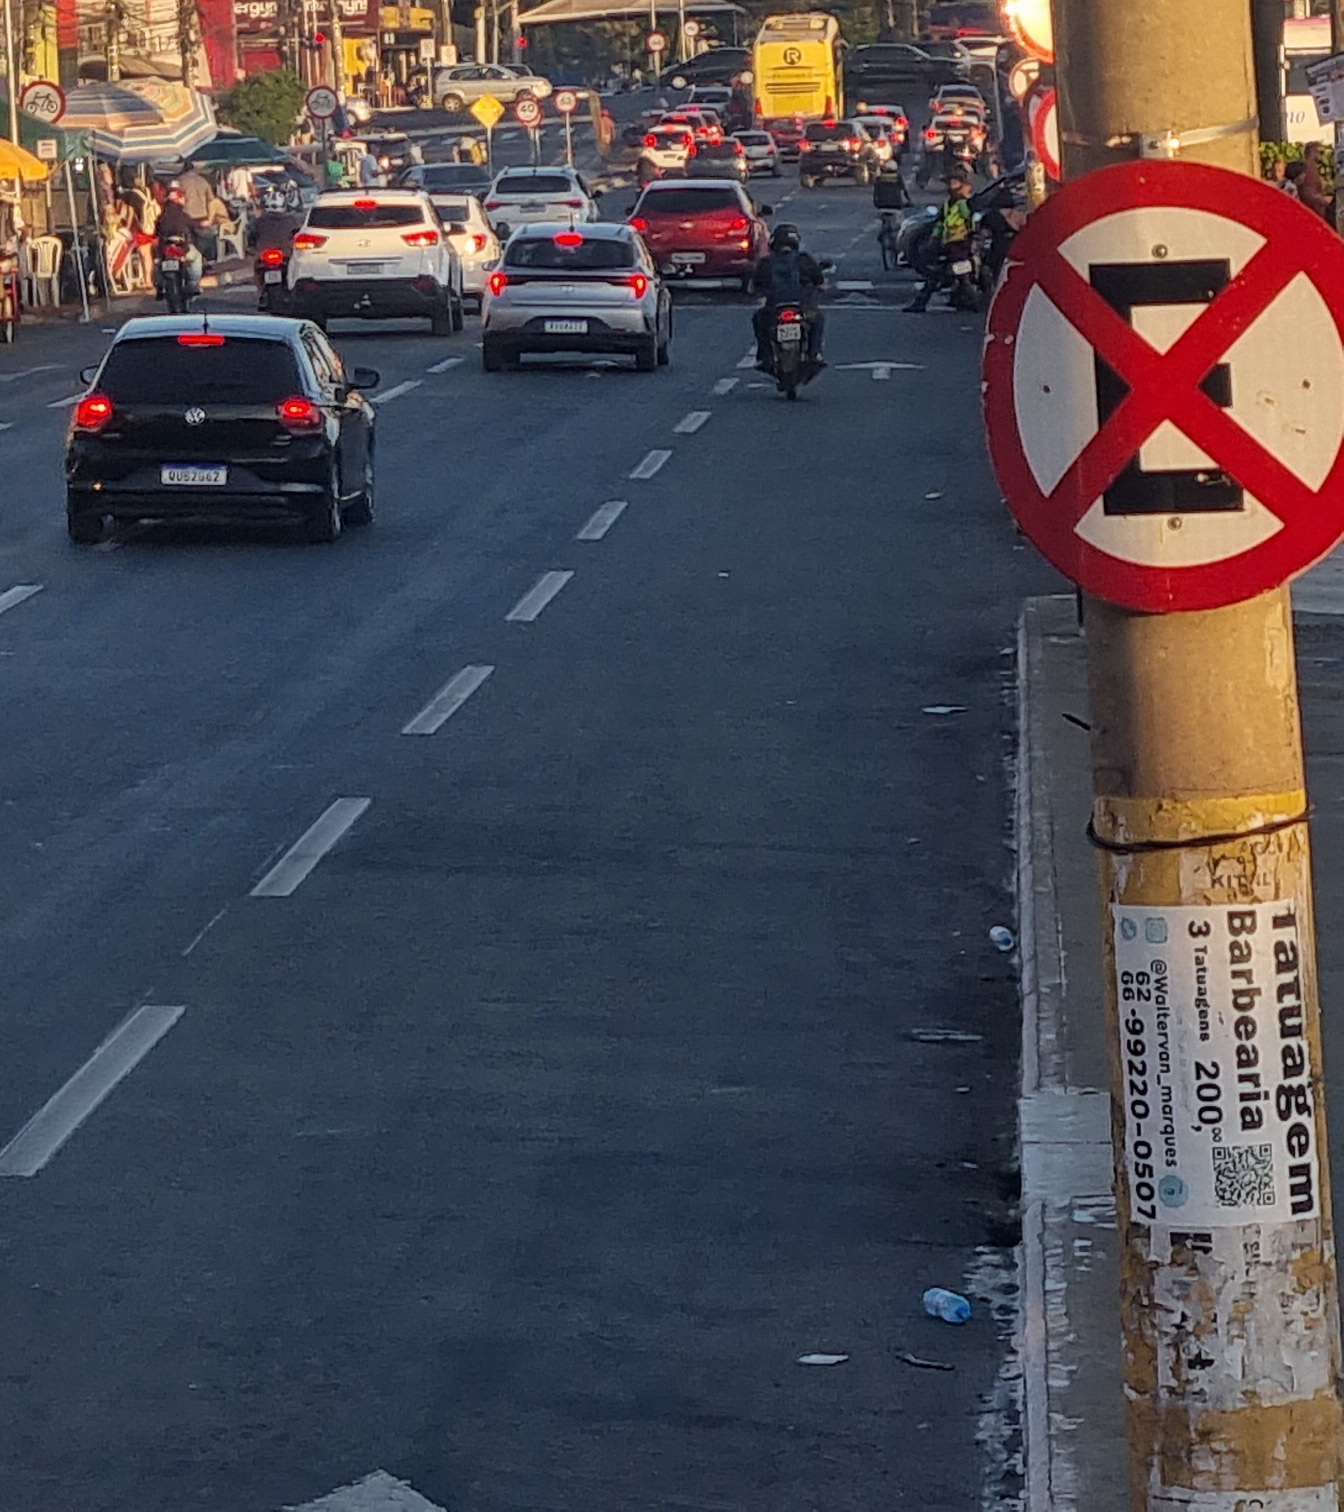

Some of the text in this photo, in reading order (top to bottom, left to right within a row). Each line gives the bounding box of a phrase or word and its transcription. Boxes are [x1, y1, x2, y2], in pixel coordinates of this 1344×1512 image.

[1089, 260, 1245, 516] E
[1188, 920, 1211, 939] 3
[1193, 944, 1211, 1043] Tatuagens
[1227, 909, 1270, 1133] Barbearia
[1271, 903, 1314, 1216] Tatuagem
